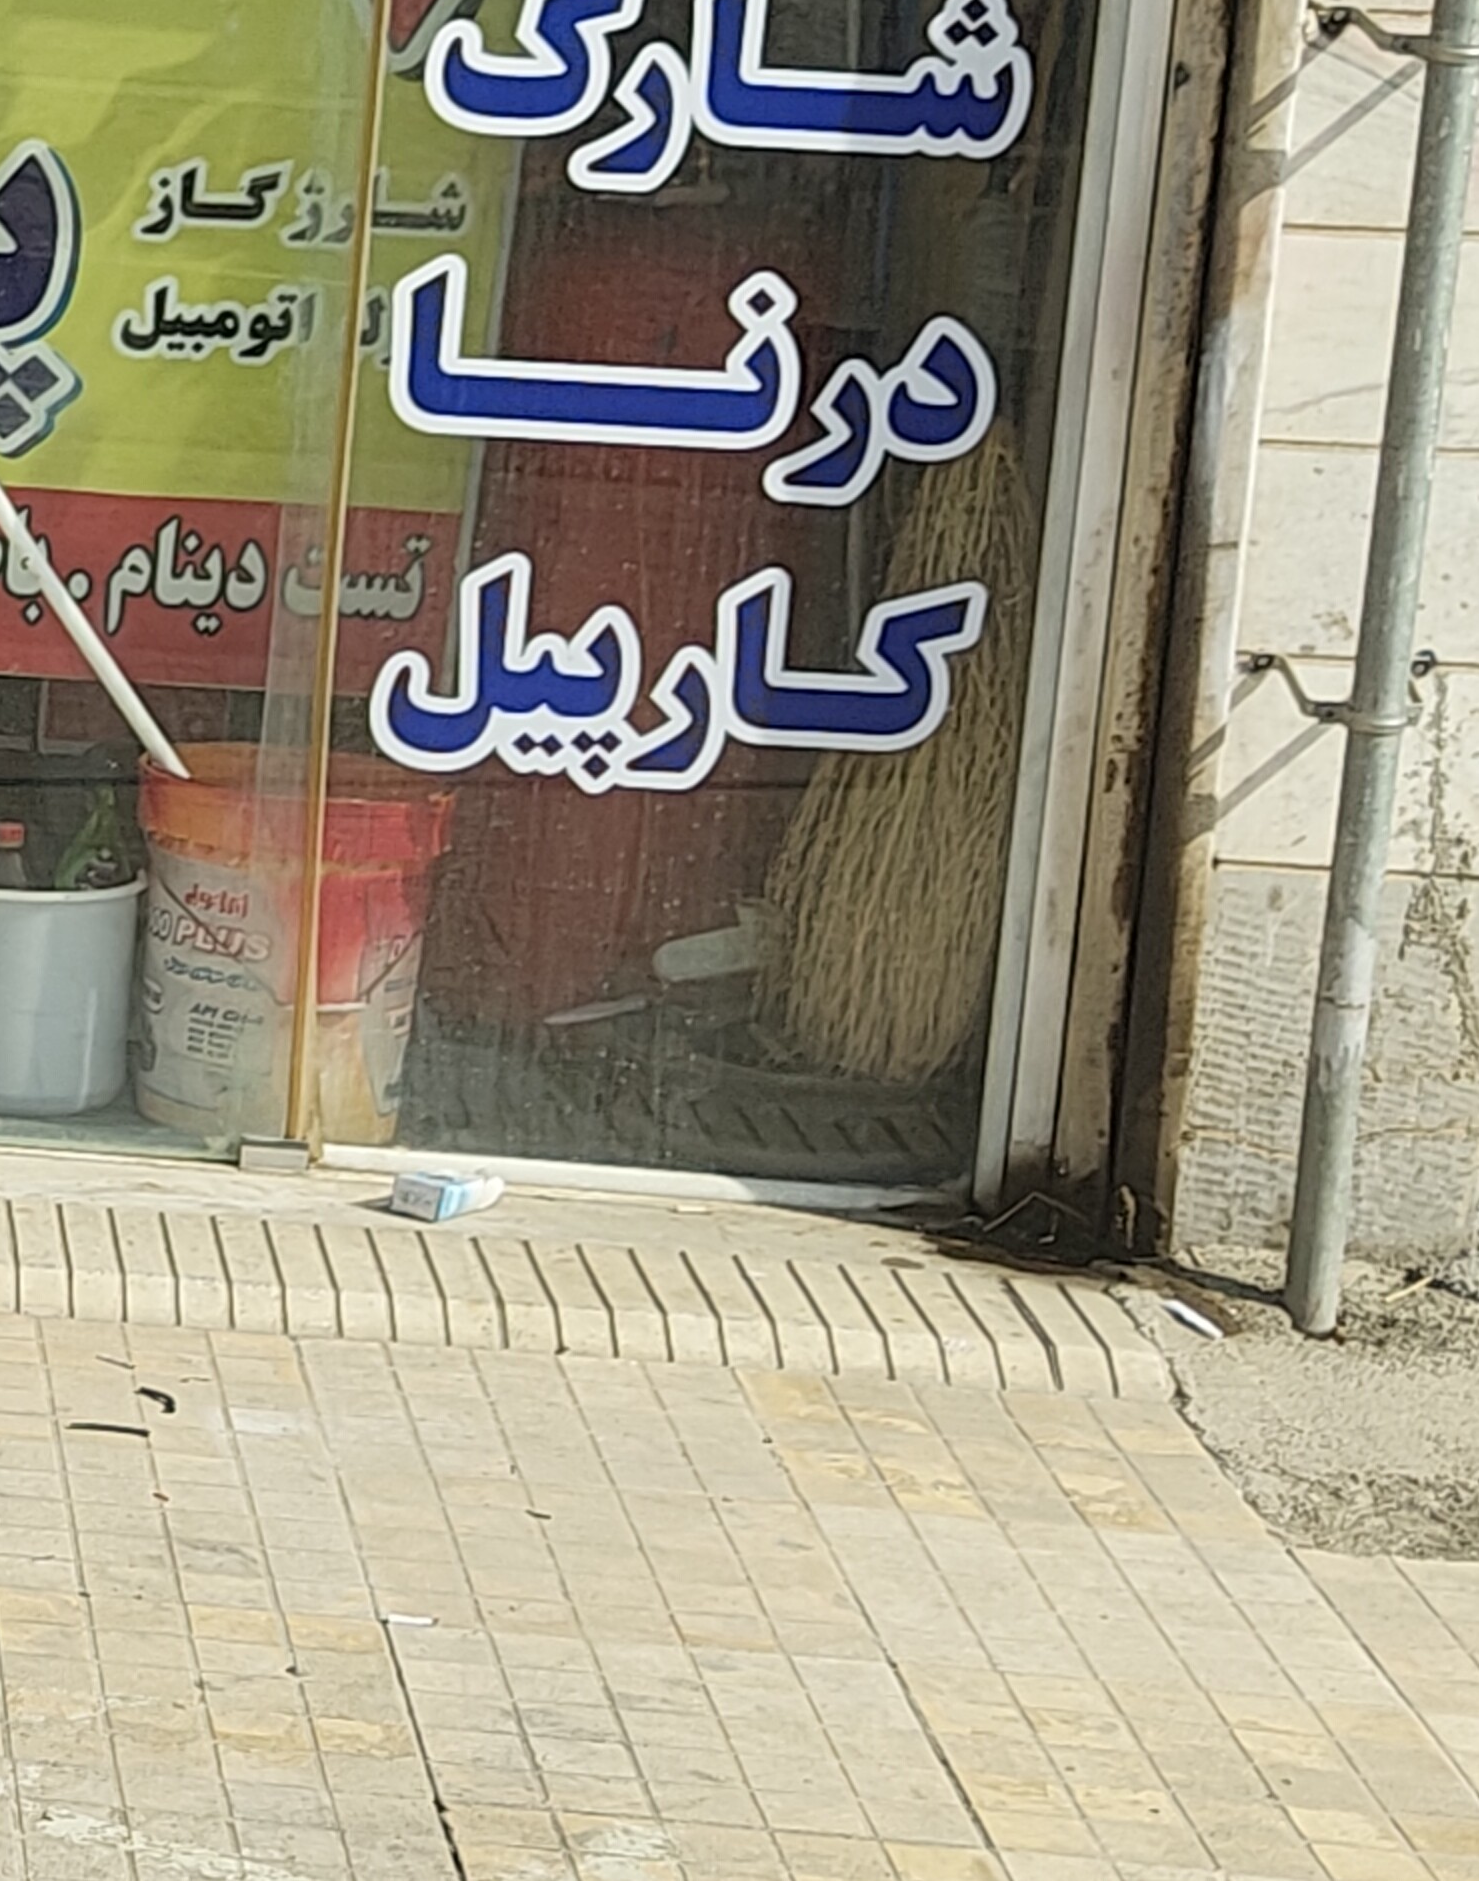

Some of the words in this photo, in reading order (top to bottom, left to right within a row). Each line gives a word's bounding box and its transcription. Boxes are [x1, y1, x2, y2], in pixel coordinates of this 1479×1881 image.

[133, 159, 293, 240] گاز
[114, 276, 321, 365] اتومبیل
[396, 259, 994, 502] درنا
[105, 515, 267, 635] دینام
[375, 558, 984, 785] کارپیل
